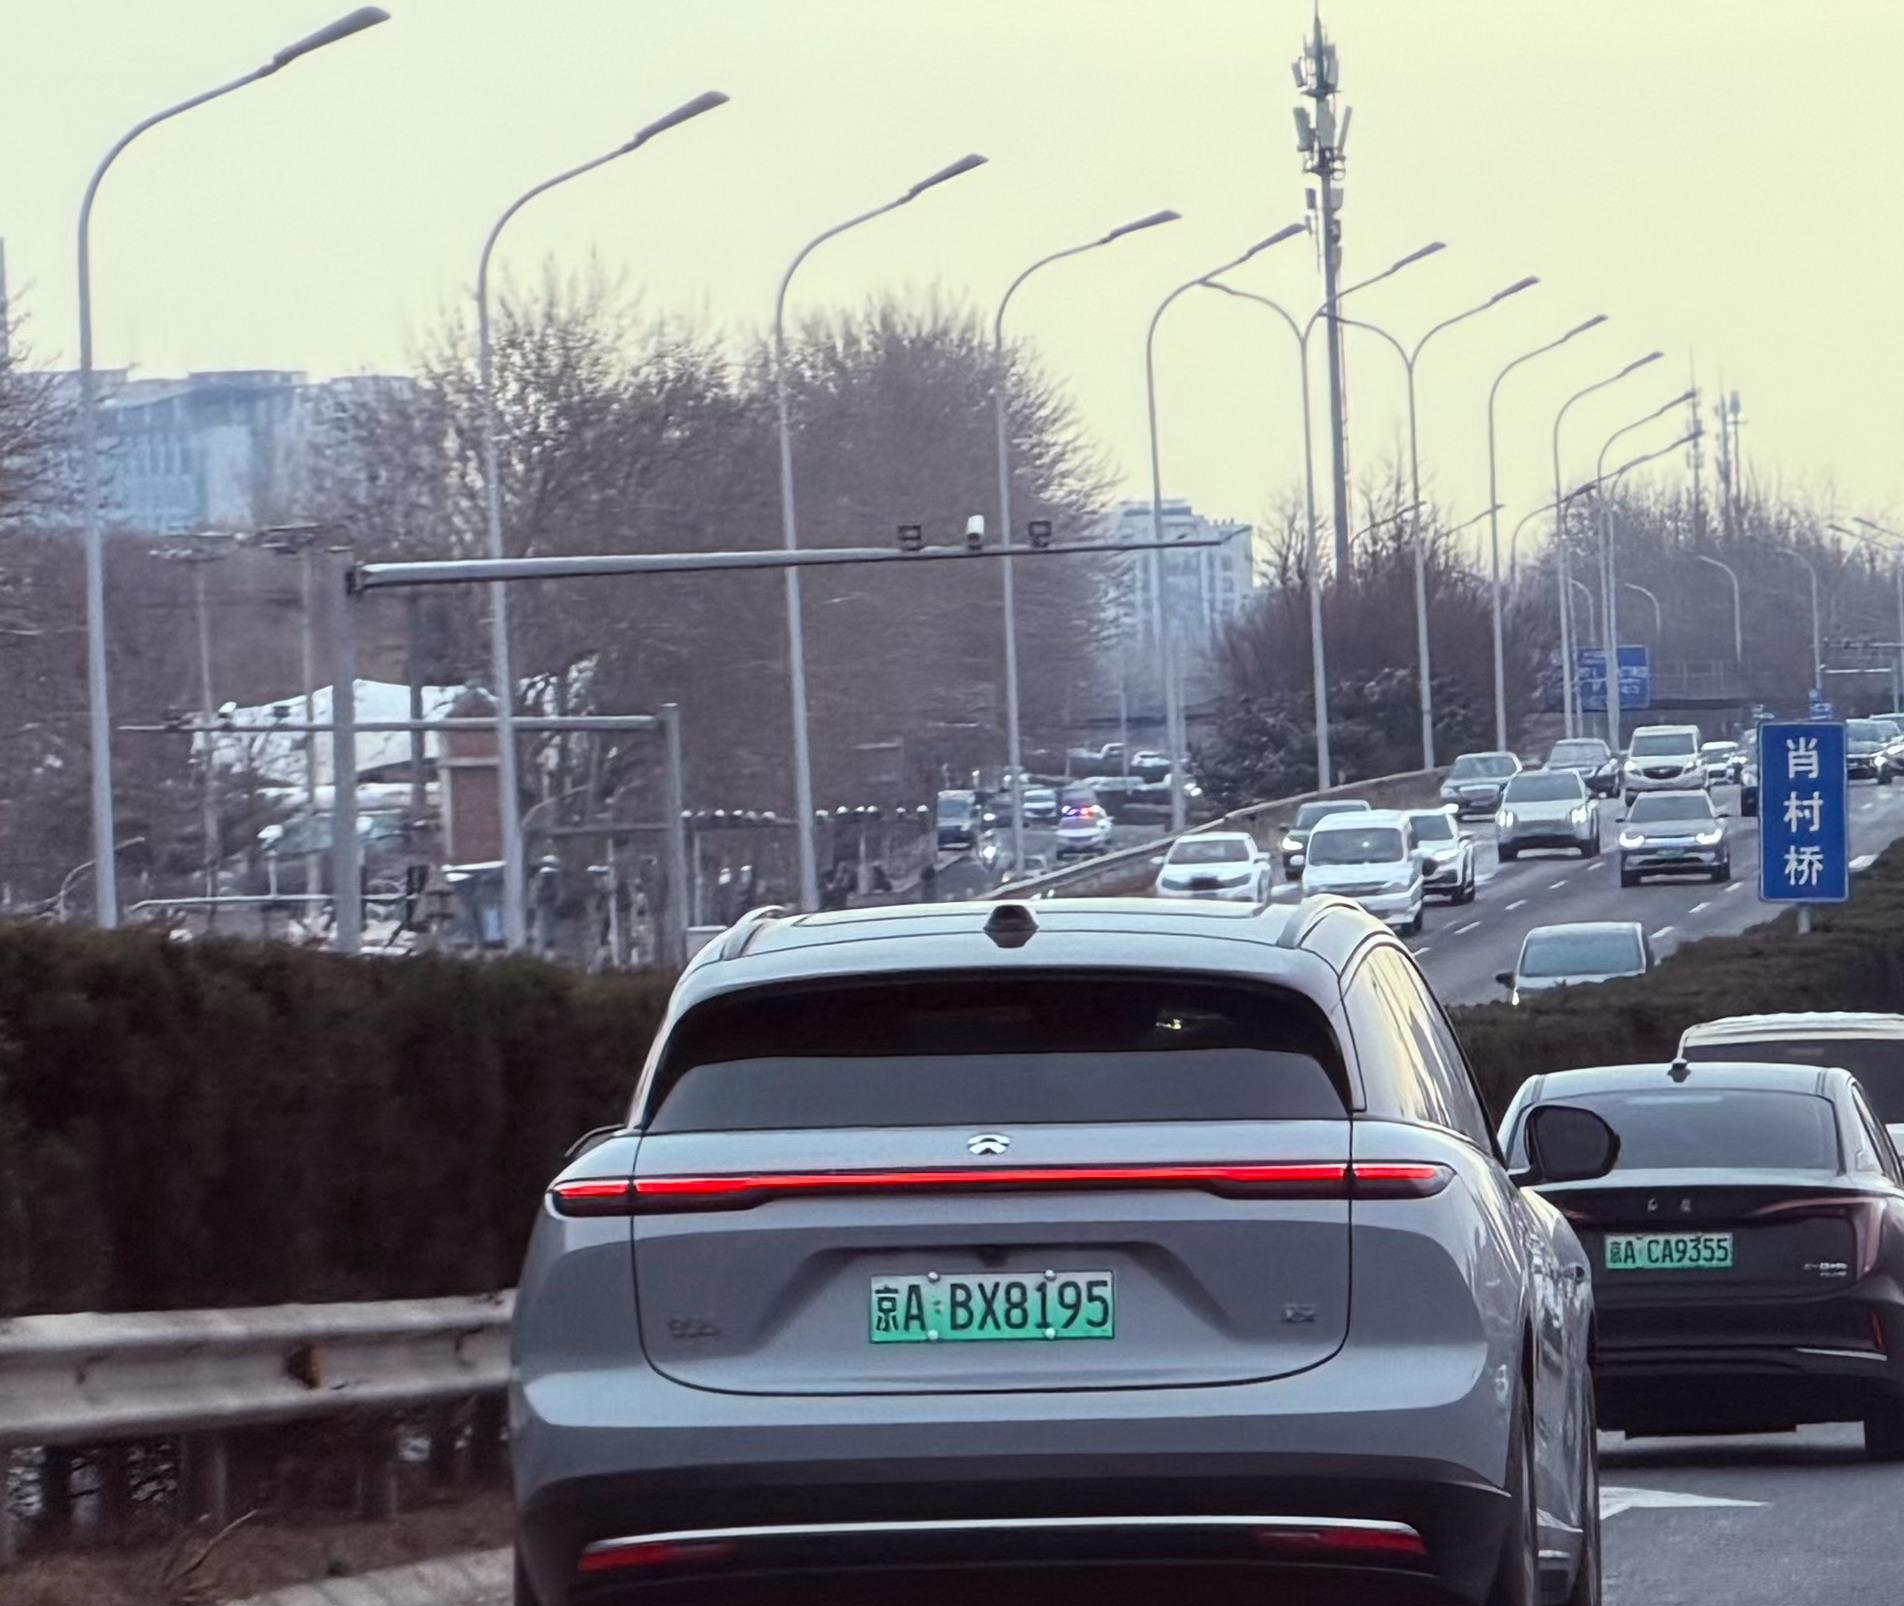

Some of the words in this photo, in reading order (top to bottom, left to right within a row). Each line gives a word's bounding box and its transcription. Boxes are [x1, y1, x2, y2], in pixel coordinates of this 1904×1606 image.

[1783, 736, 1824, 887] 肖村桥
[1647, 1238, 1729, 1263] CA9355
[874, 1284, 926, 1332] 京A
[949, 1280, 1110, 1331] BX8195
